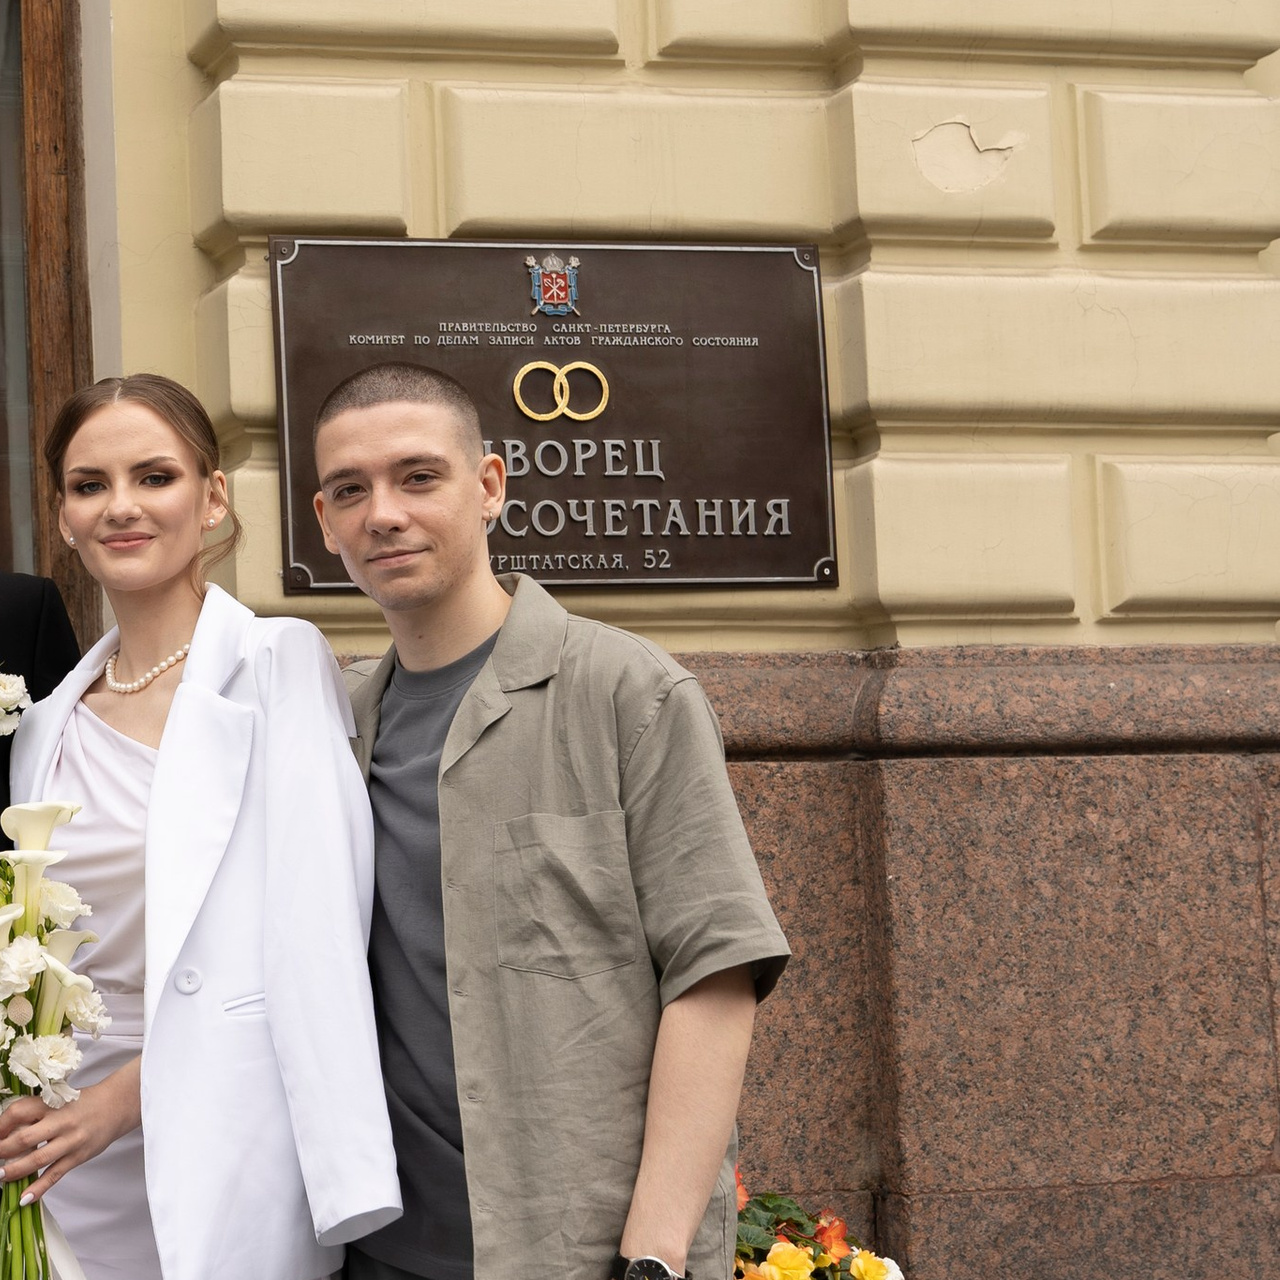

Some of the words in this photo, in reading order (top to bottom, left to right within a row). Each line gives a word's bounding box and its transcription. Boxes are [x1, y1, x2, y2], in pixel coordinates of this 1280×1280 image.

[439, 322, 537, 332] ПРАВИТЕЛЬСТВО
[552, 323, 671, 333] САНКТ-ПЕТЕРБУРГА
[349, 334, 405, 345] КОМИТЕТ
[414, 335, 431, 345] ПО
[437, 335, 479, 346] ДЕЛАМ
[488, 335, 534, 346] ЗАПИСИ
[543, 336, 581, 346] АКТОВ
[591, 336, 684, 347] ГРАЖДАНСКОГО
[692, 336, 759, 347] СОСТОЯНИЯ
[486, 499, 792, 537] СОЧЕТАНИЯ
[643, 549, 671, 569] 52
